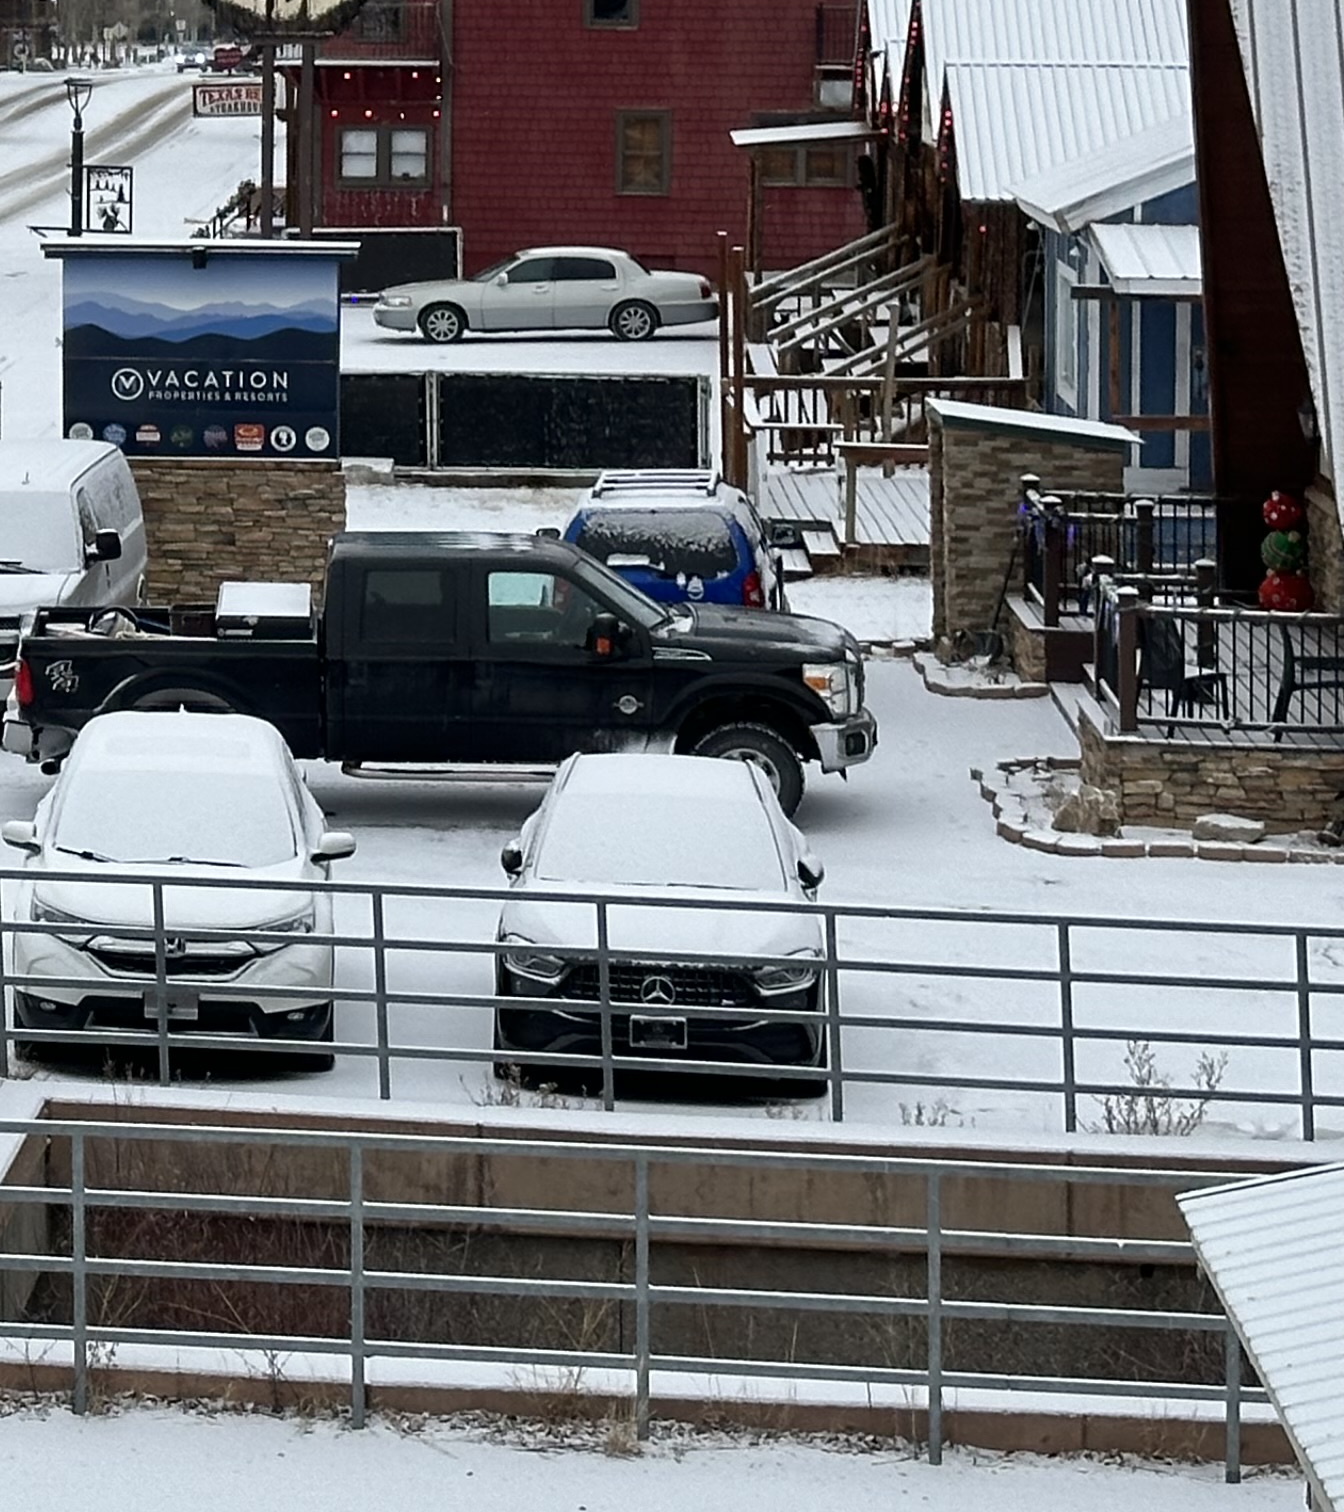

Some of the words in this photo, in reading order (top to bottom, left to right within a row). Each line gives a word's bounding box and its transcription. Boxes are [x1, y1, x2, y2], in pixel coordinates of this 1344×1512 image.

[147, 370, 289, 390] VACATION
[148, 390, 221, 402] PROPERTIES
[224, 391, 232, 402] &
[235, 392, 289, 403] RESORTS
